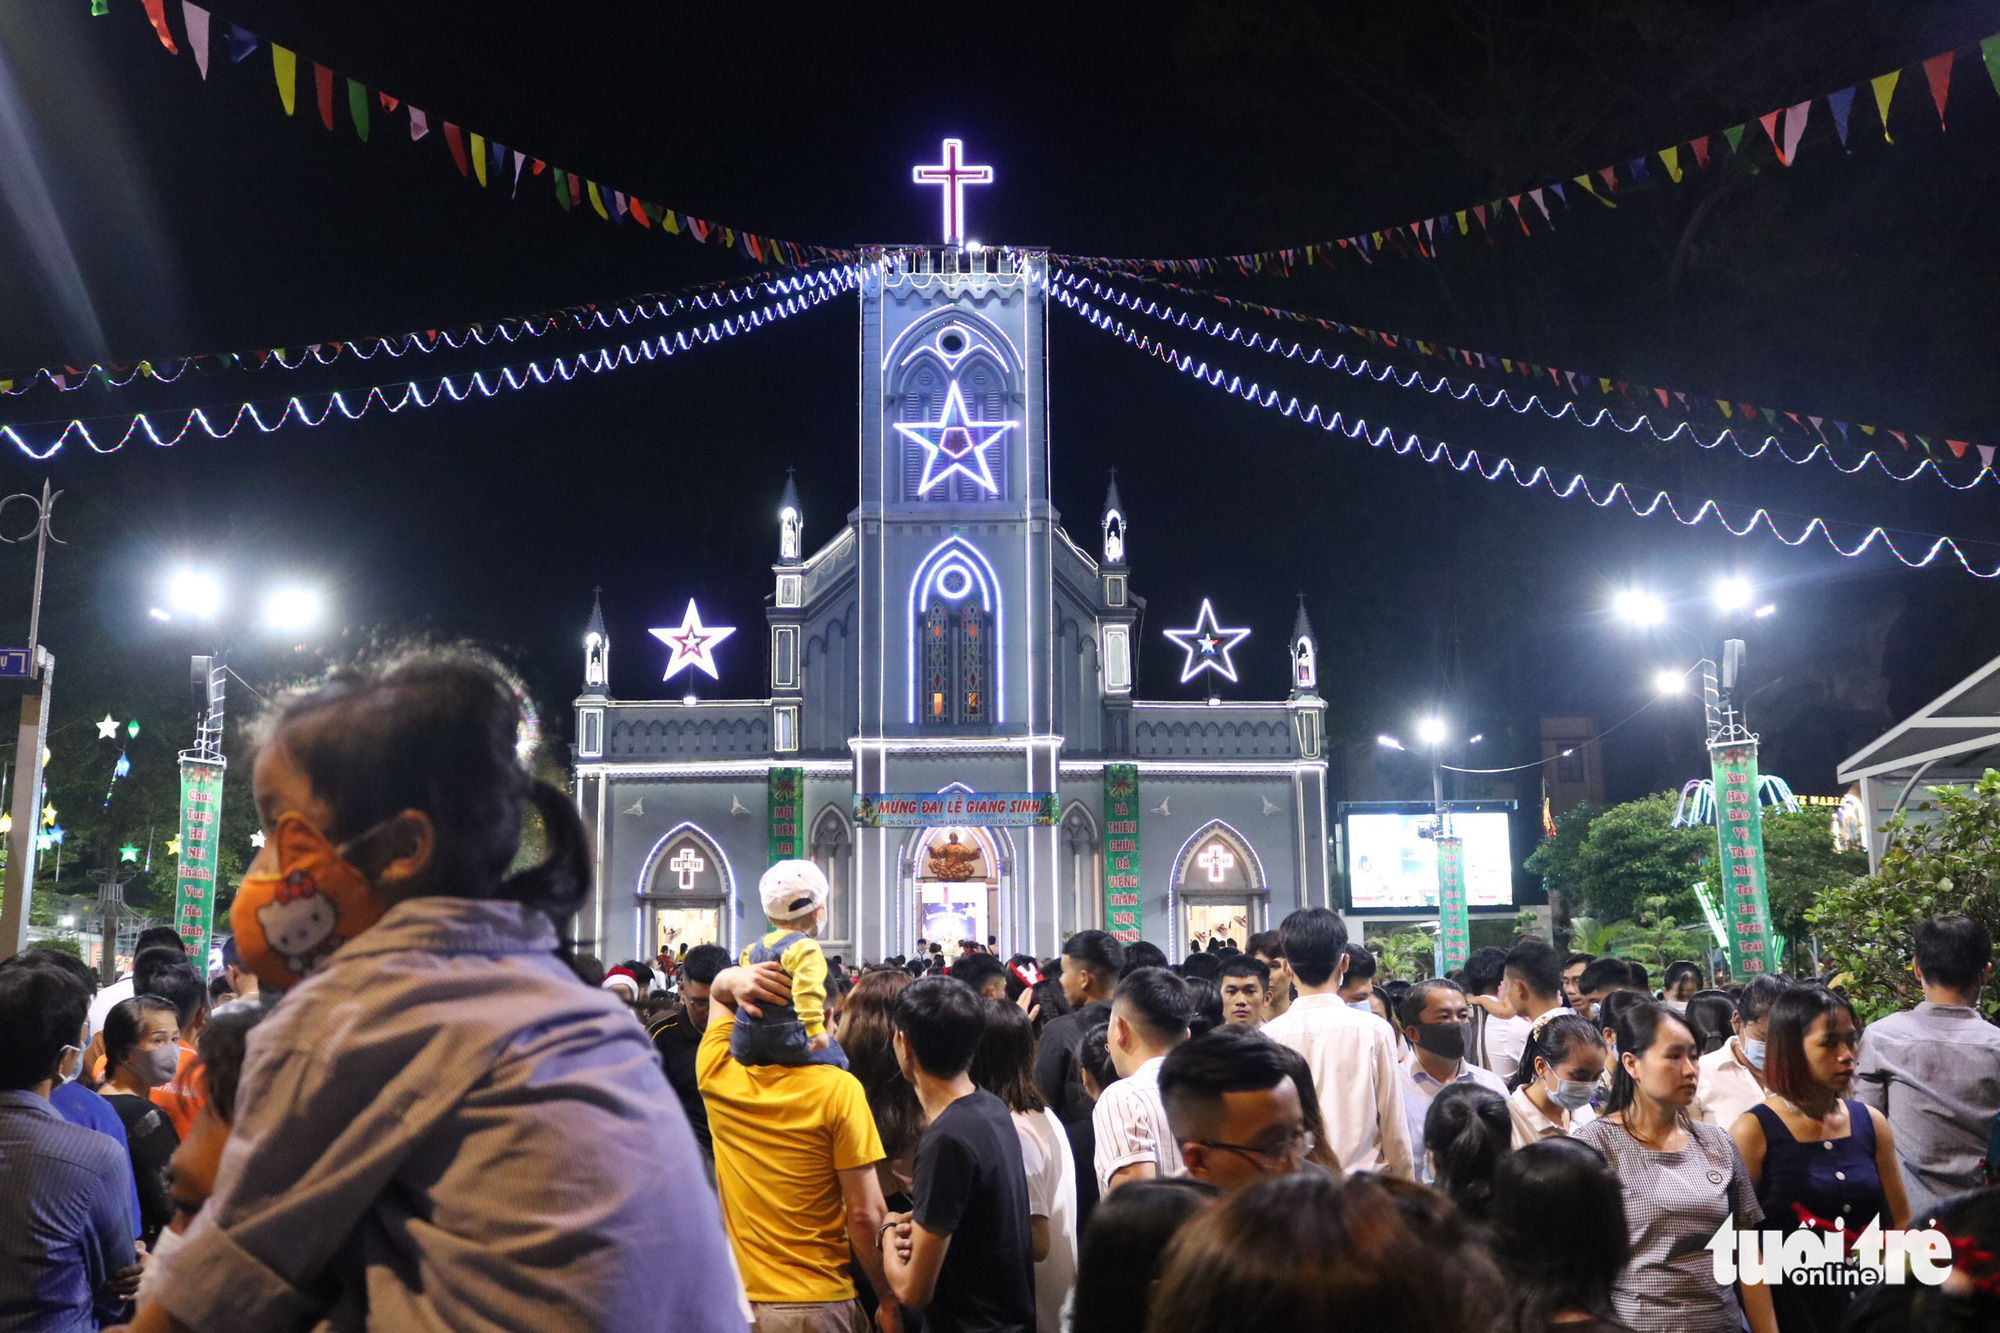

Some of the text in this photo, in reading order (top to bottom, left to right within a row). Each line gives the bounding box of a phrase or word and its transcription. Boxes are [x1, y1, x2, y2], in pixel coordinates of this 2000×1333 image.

[1726, 772, 1747, 784] Xin
[188, 789, 213, 803] Chúc
[1727, 790, 1749, 804] Hãy
[878, 795, 1041, 817] MỪNG ĐẠI LỄ GIÁNG SINH
[187, 808, 212, 825] Tụng
[187, 847, 206, 860] Nhi
[1730, 846, 1756, 858] Thai
[184, 885, 204, 898] Vua
[1739, 903, 1756, 914] Em
